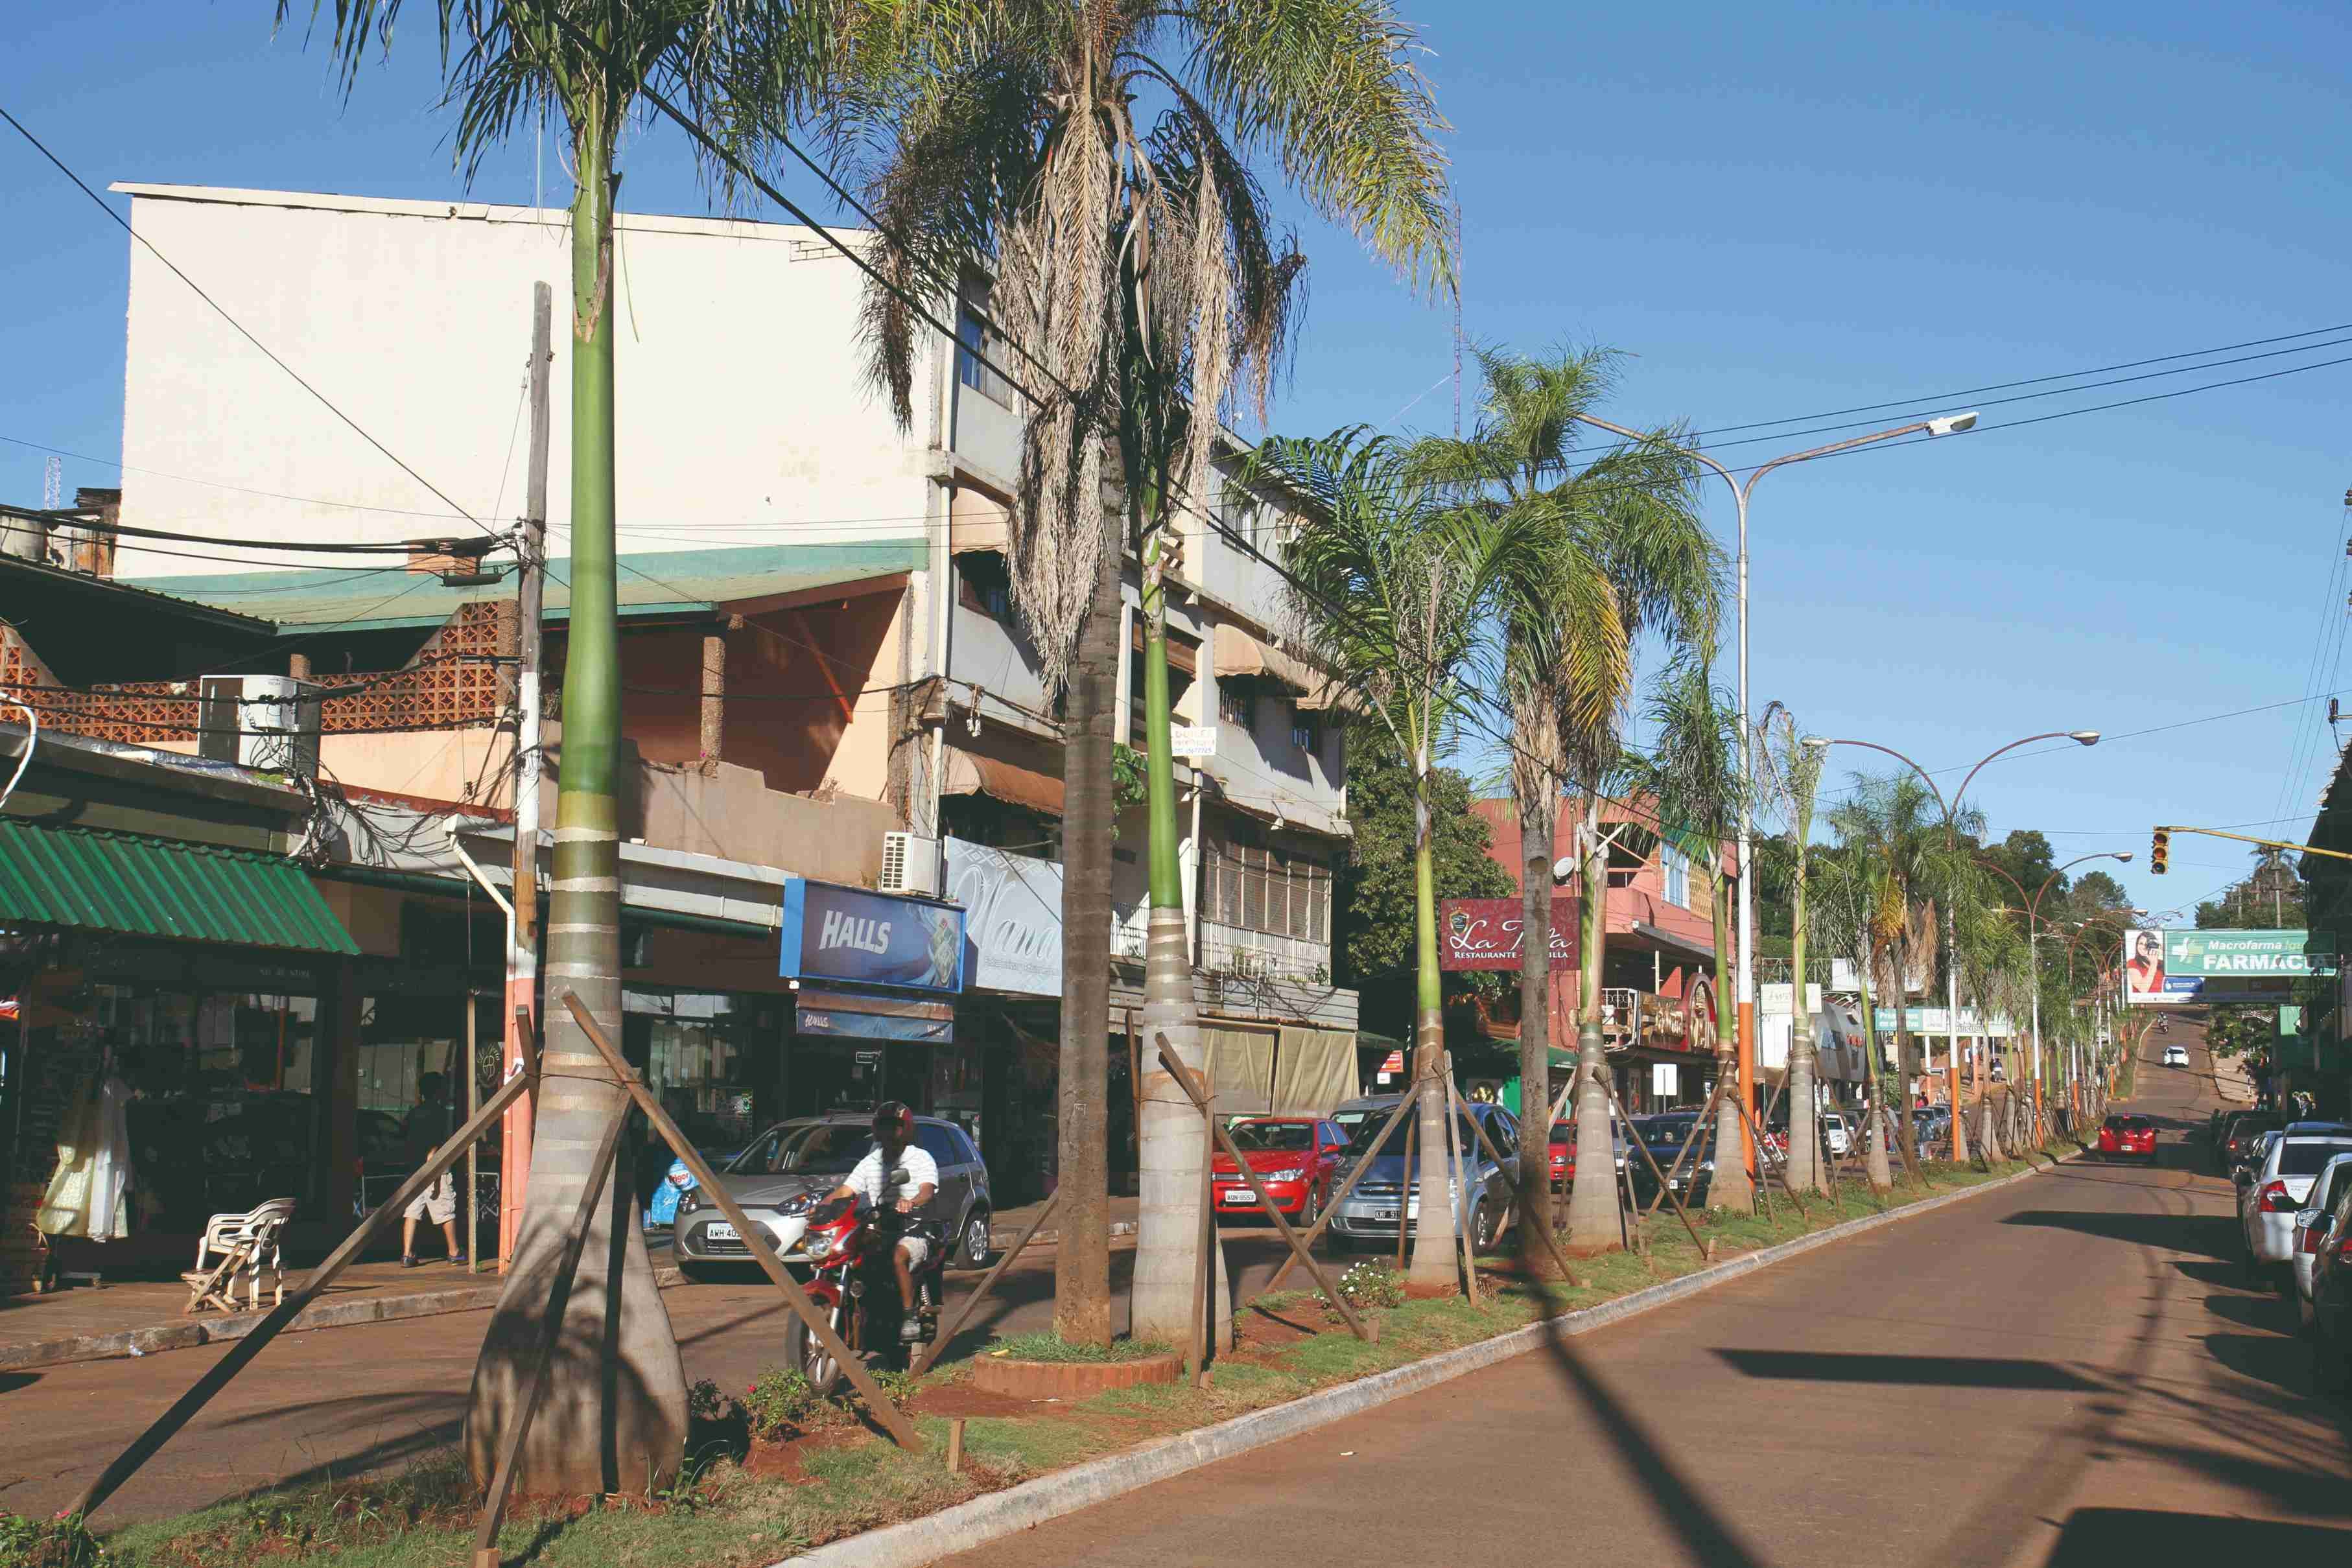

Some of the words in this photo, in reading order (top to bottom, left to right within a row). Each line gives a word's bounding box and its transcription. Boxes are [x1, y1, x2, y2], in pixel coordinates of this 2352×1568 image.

[819, 909, 892, 955] HALLS
[1450, 920, 1499, 950] La
[2208, 940, 2281, 950] Macrofarma
[805, 1014, 830, 1027] HALLS
